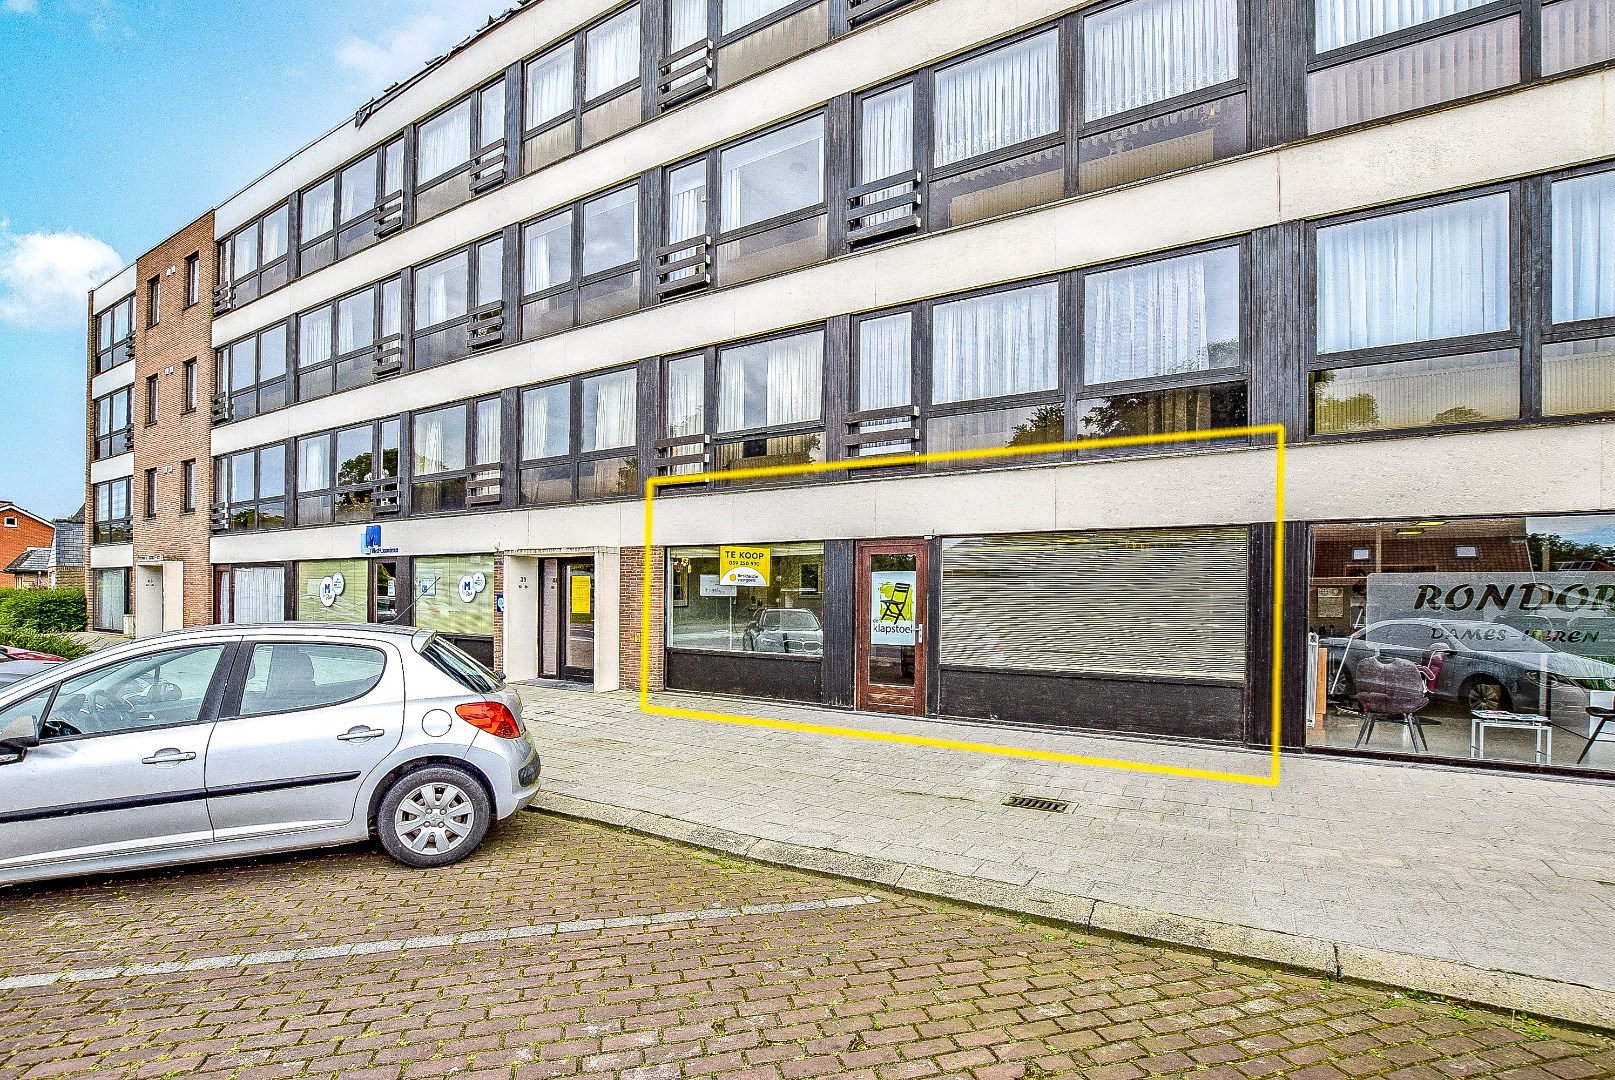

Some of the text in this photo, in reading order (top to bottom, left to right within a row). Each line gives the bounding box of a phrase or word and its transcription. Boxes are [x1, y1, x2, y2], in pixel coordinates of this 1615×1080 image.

[724, 550, 764, 560] TE KOOP
[873, 623, 913, 635] klapstoel
